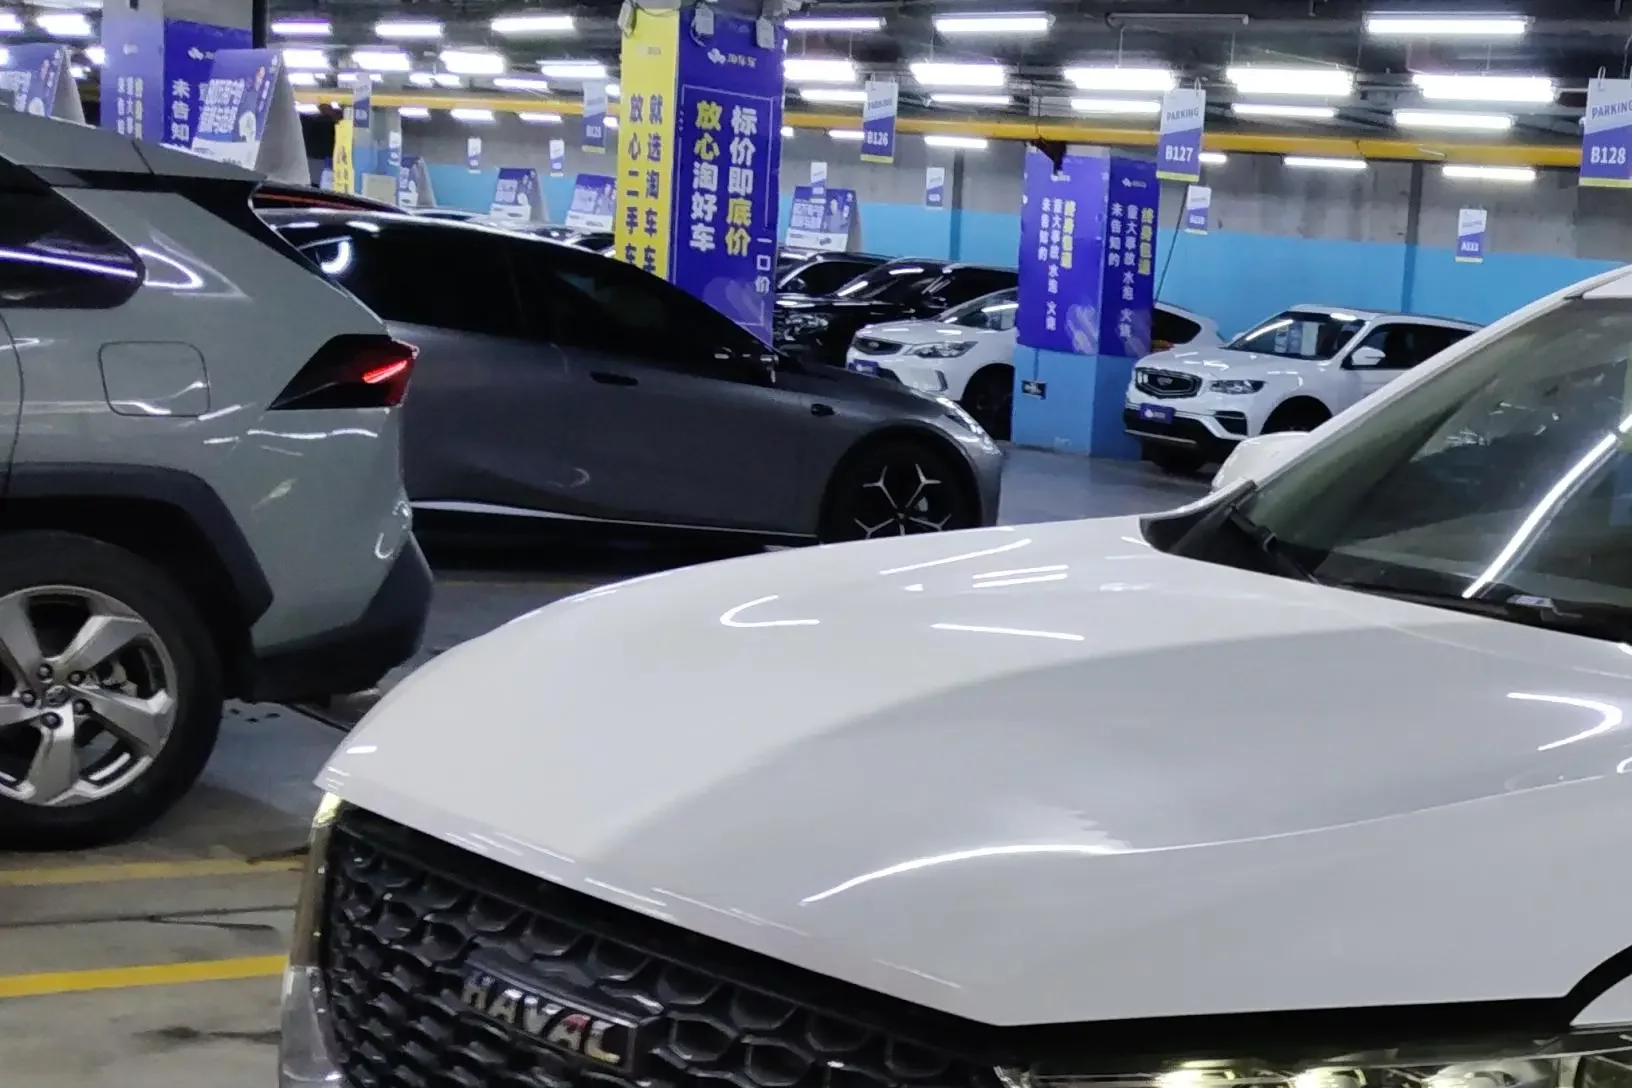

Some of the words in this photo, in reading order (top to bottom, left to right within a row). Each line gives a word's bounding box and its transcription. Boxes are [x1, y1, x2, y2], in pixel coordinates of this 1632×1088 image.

[867, 131, 889, 147] B126
[1166, 106, 1199, 122] PARKING
[689, 100, 723, 252] 放心淘好车
[725, 104, 758, 256] 标价即底价
[1165, 145, 1194, 162] B127
[1590, 146, 1626, 165] B128
[645, 94, 663, 273] 就选淘车车
[755, 237, 772, 295] 一口价
[461, 970, 620, 1064] HAVAL
